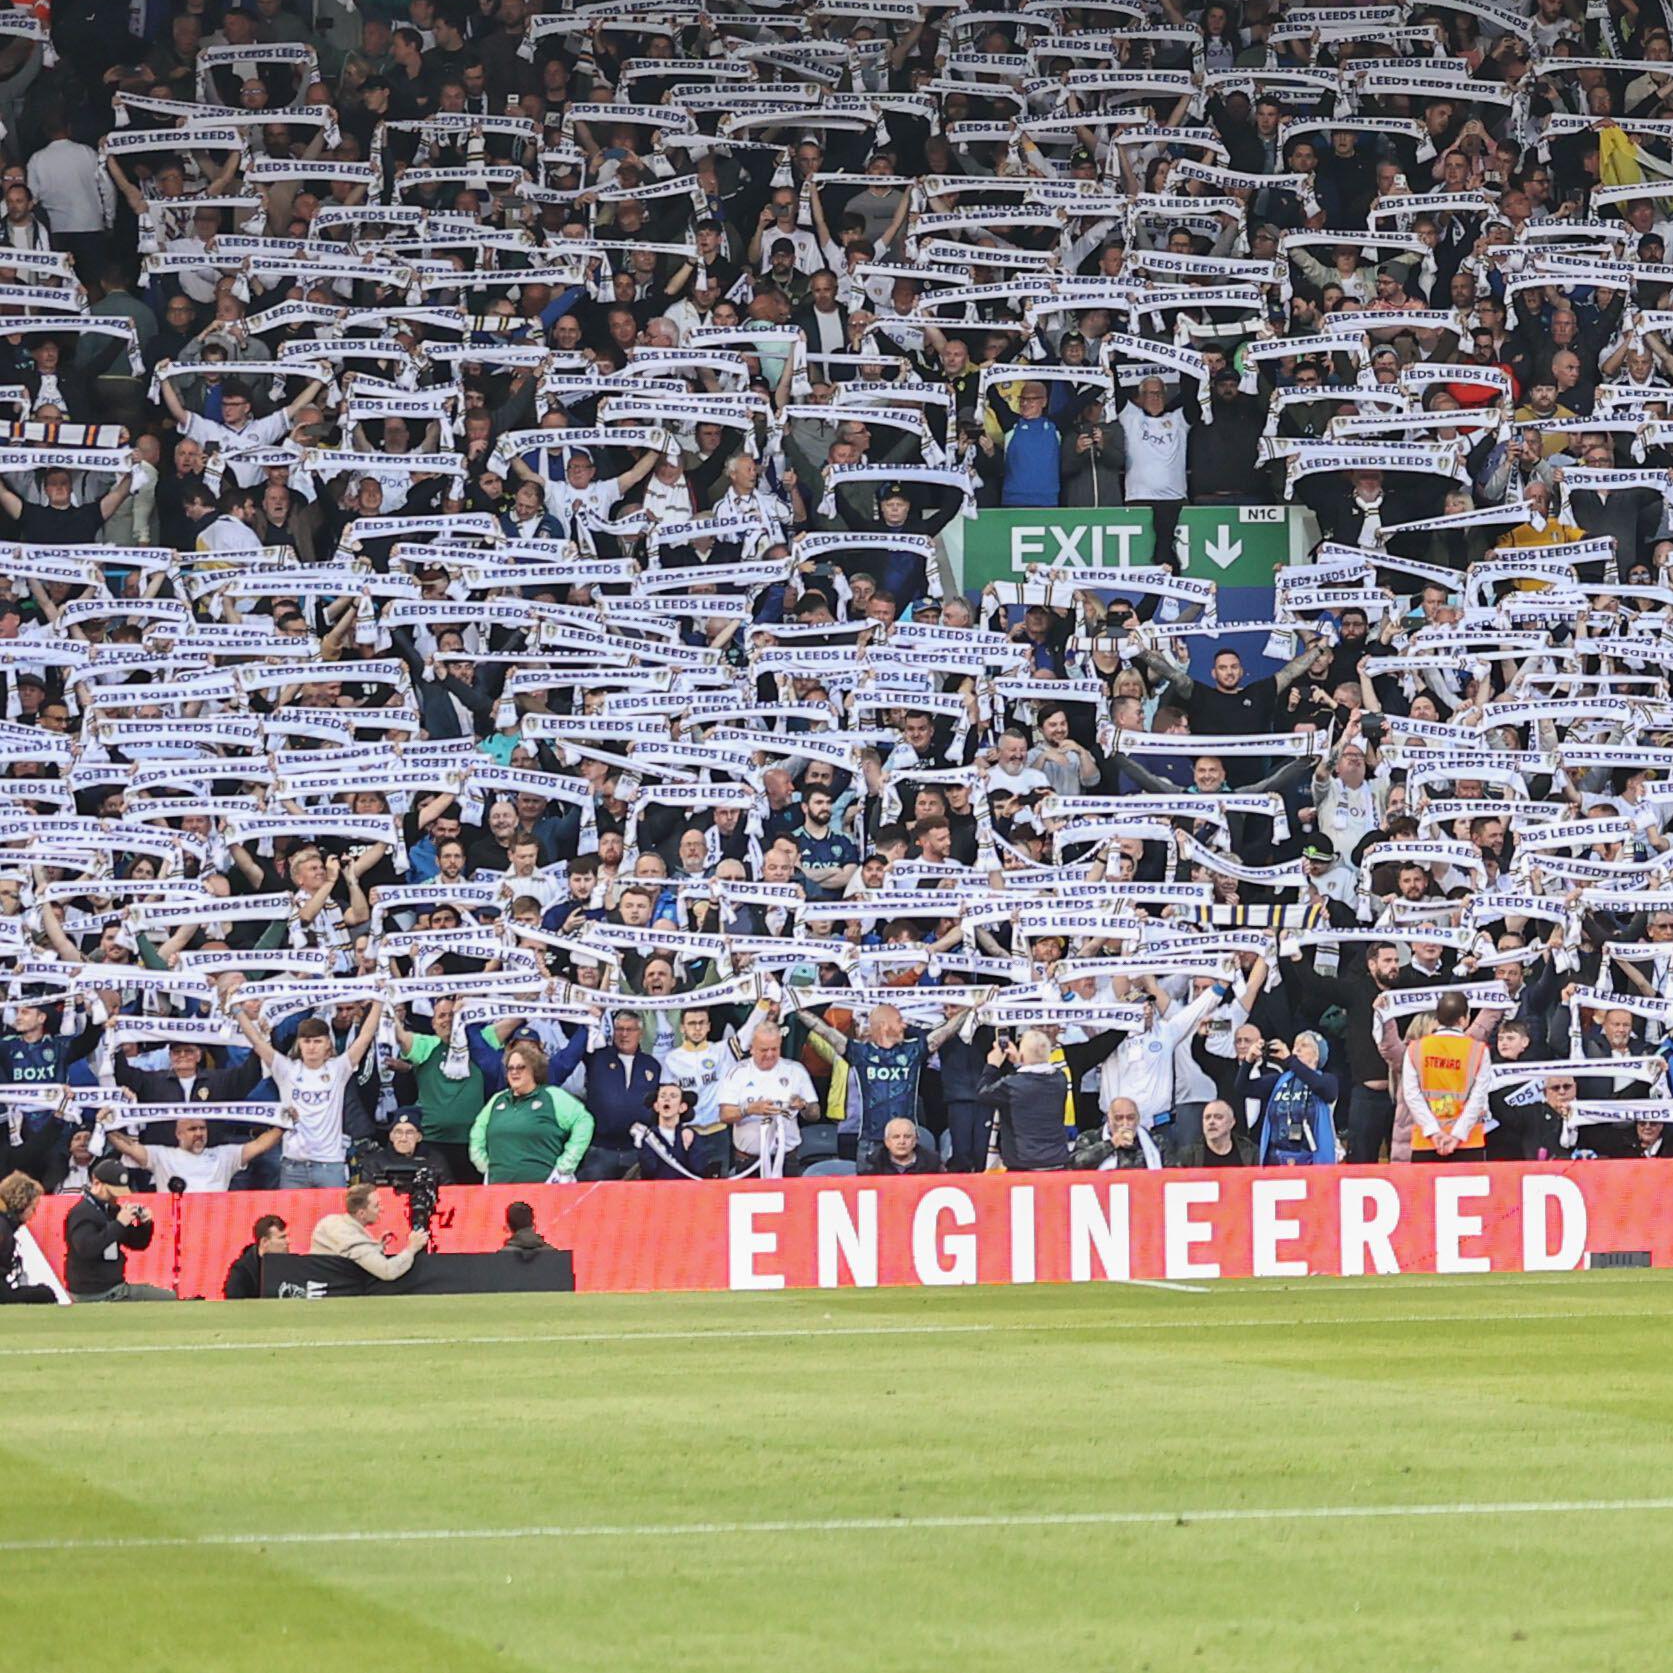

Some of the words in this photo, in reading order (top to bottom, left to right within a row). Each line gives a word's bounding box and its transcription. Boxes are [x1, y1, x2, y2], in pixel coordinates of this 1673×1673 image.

[1319, 11, 1356, 21] LEEDS
[1360, 9, 1395, 20] LEEDS
[1102, 73, 1145, 83] LEEDS
[1149, 73, 1188, 85] LEEDS
[107, 133, 145, 147] LEEDS
[150, 131, 190, 142] LEEDS
[195, 130, 234, 141] LEEDS
[1550, 256, 1591, 267] LEEDS
[1595, 261, 1636, 272] LEEDS
[1247, 508, 1277, 521] N1C
[1011, 525, 1142, 572] EXIT
[1073, 571, 1116, 582] LEEDS
[1121, 572, 1164, 585] LEEDS
[1168, 580, 1209, 596] LEEDS
[609, 600, 650, 612] LEEDS
[655, 599, 696, 610] LEEDS
[702, 599, 744, 612] LEEDS
[561, 630, 602, 643] LEEDS
[607, 638, 650, 652] LEEDS
[655, 648, 697, 661] LEEDS
[653, 787, 695, 798] LEEDS
[701, 786, 745, 798] LEEDS
[404, 888, 446, 899] LEEDS
[451, 888, 493, 900] LEEDS
[1062, 885, 1107, 897] LEEDS
[1112, 885, 1154, 896] LEEDS
[1159, 885, 1204, 897] LEEDS
[145, 906, 191, 919] LEEDS
[247, 897, 290, 909] LEEDS
[998, 899, 1043, 911] LEEDS
[1051, 899, 1094, 910] LEEDS
[1174, 936, 1218, 948] LEEDS
[1224, 933, 1267, 948] LEEDS
[1424, 1055, 1462, 1071] STEWARD
[13, 1065, 55, 1081] BOXT
[866, 1066, 910, 1081] BOXT
[292, 1089, 332, 1103] BOXT
[1625, 1108, 1669, 1120] LEEDS
[728, 1171, 1588, 1290] ENGINEERED
